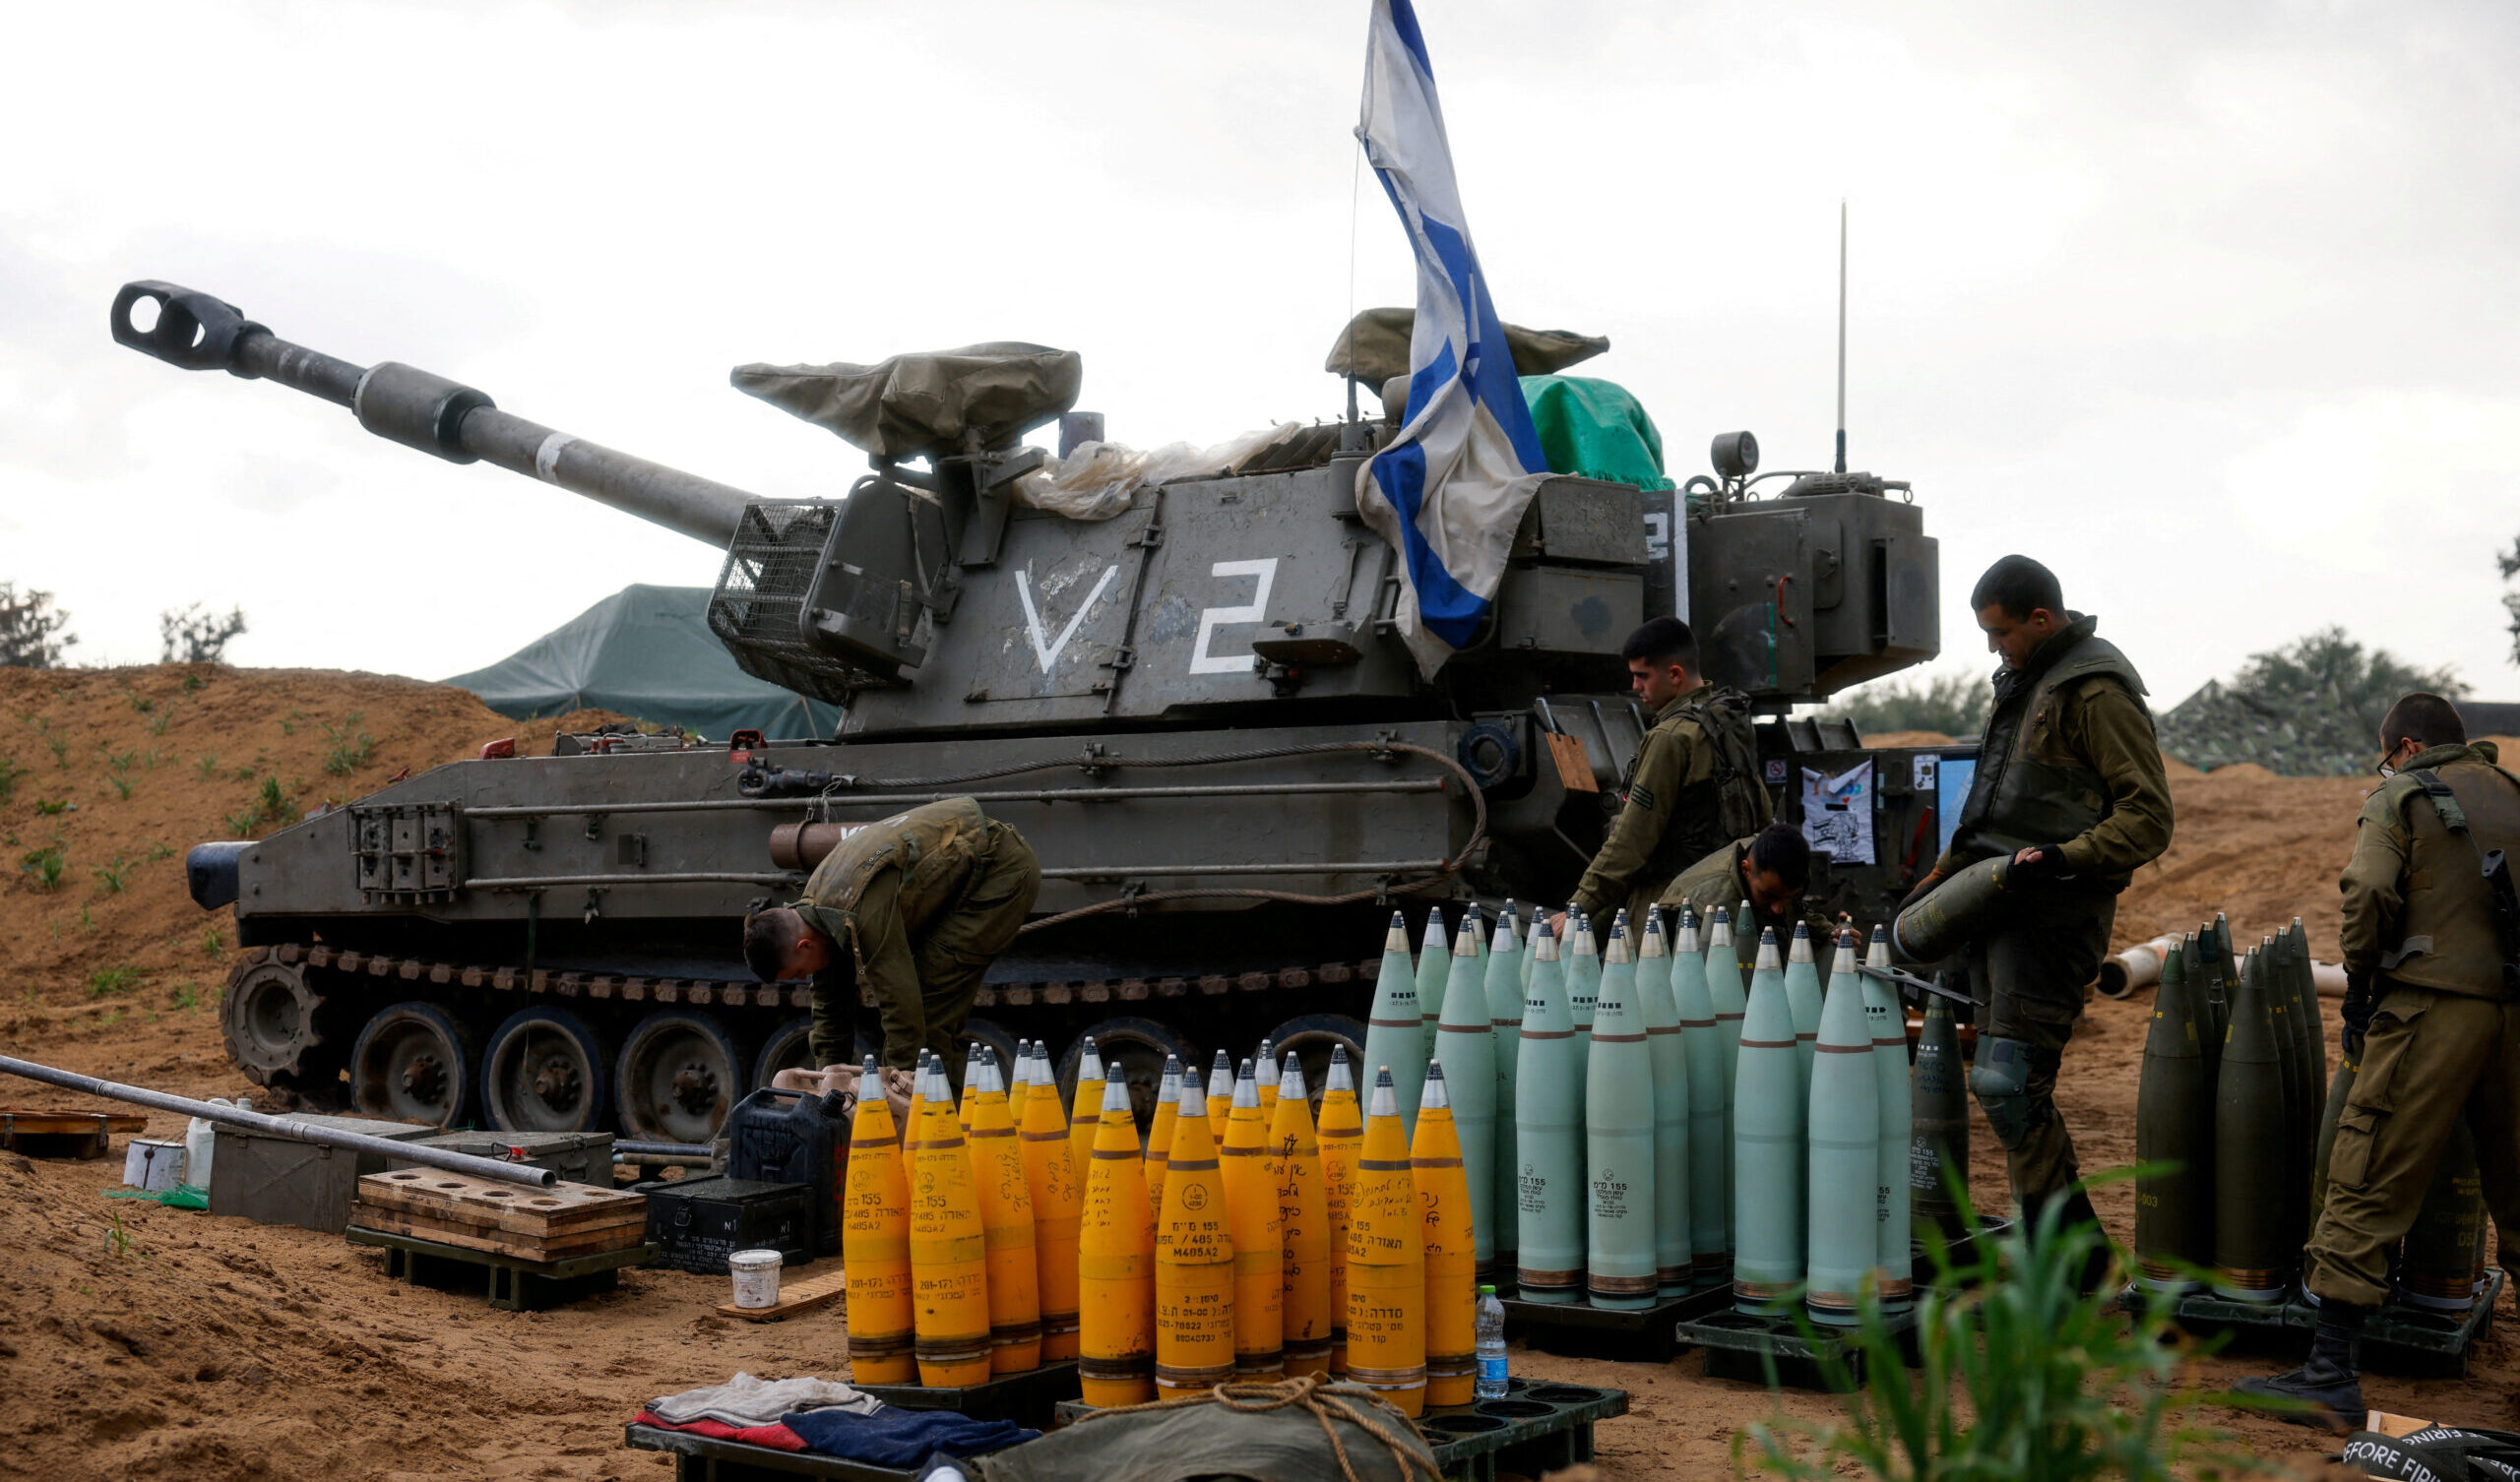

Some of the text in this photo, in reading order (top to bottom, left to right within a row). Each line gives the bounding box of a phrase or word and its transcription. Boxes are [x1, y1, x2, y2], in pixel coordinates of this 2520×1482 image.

[1189, 558, 1279, 674] 2
[861, 1193, 882, 1205] 155
[926, 1195, 947, 1207] 155
[1203, 1222, 1220, 1231] 155
[1356, 1220, 1371, 1232] 155
[1367, 1236, 1403, 1250] תאורה
[2402, 1429, 2463, 1446] FIRING
[2343, 1441, 2402, 1469] EFORE
